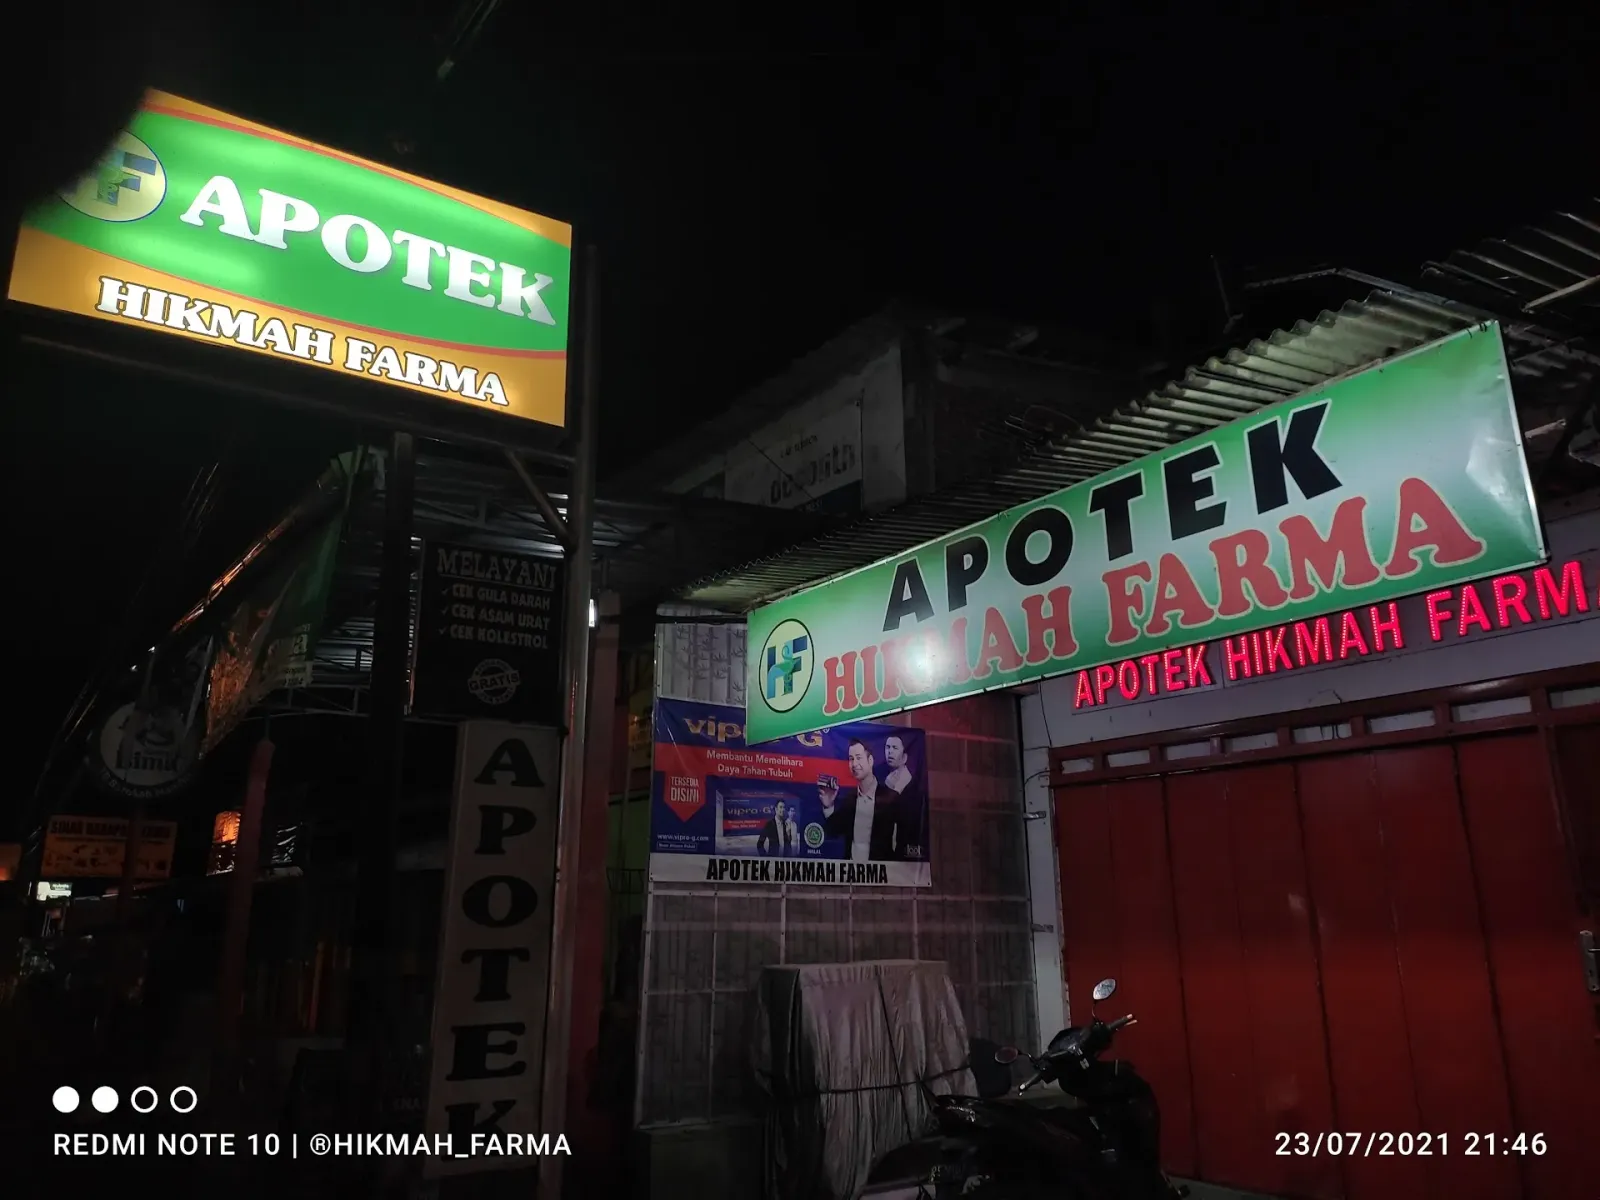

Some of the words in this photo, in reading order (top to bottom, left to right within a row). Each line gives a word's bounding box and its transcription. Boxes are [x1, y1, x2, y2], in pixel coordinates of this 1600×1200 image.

[180, 175, 556, 326] APOTEK
[95, 276, 335, 365] HIKMAH
[345, 336, 509, 406] FARMA
[882, 399, 1343, 632] APOTEK
[436, 548, 557, 590] MELAYANI
[1101, 476, 1487, 646] FARMA
[452, 583, 474, 599] CEK
[477, 588, 508, 605] GULA
[511, 593, 550, 611] DARAH
[451, 603, 476, 621] CEK
[478, 605, 514, 627] ASAM
[517, 612, 550, 631] URAT
[450, 623, 474, 640] CEK
[477, 626, 549, 650] KOLESTROL
[1074, 642, 1215, 709] APOTEK
[1224, 600, 1405, 681] HIKMAH
[1425, 559, 1600, 642] FARM
[469, 670, 521, 692] GRATIS
[706, 749, 753, 763] Membantu
[755, 754, 804, 768] Memelihara
[717, 763, 740, 775] Daya
[742, 765, 767, 777] Tahan
[768, 767, 793, 779] Tubuh
[670, 776, 700, 788] TERSEDIA
[670, 787, 700, 803] DISINI
[706, 858, 771, 882] APOTEK
[774, 861, 836, 883] HIKMAH
[839, 863, 888, 884] FARMA
[441, 738, 545, 1162] APOTEK
